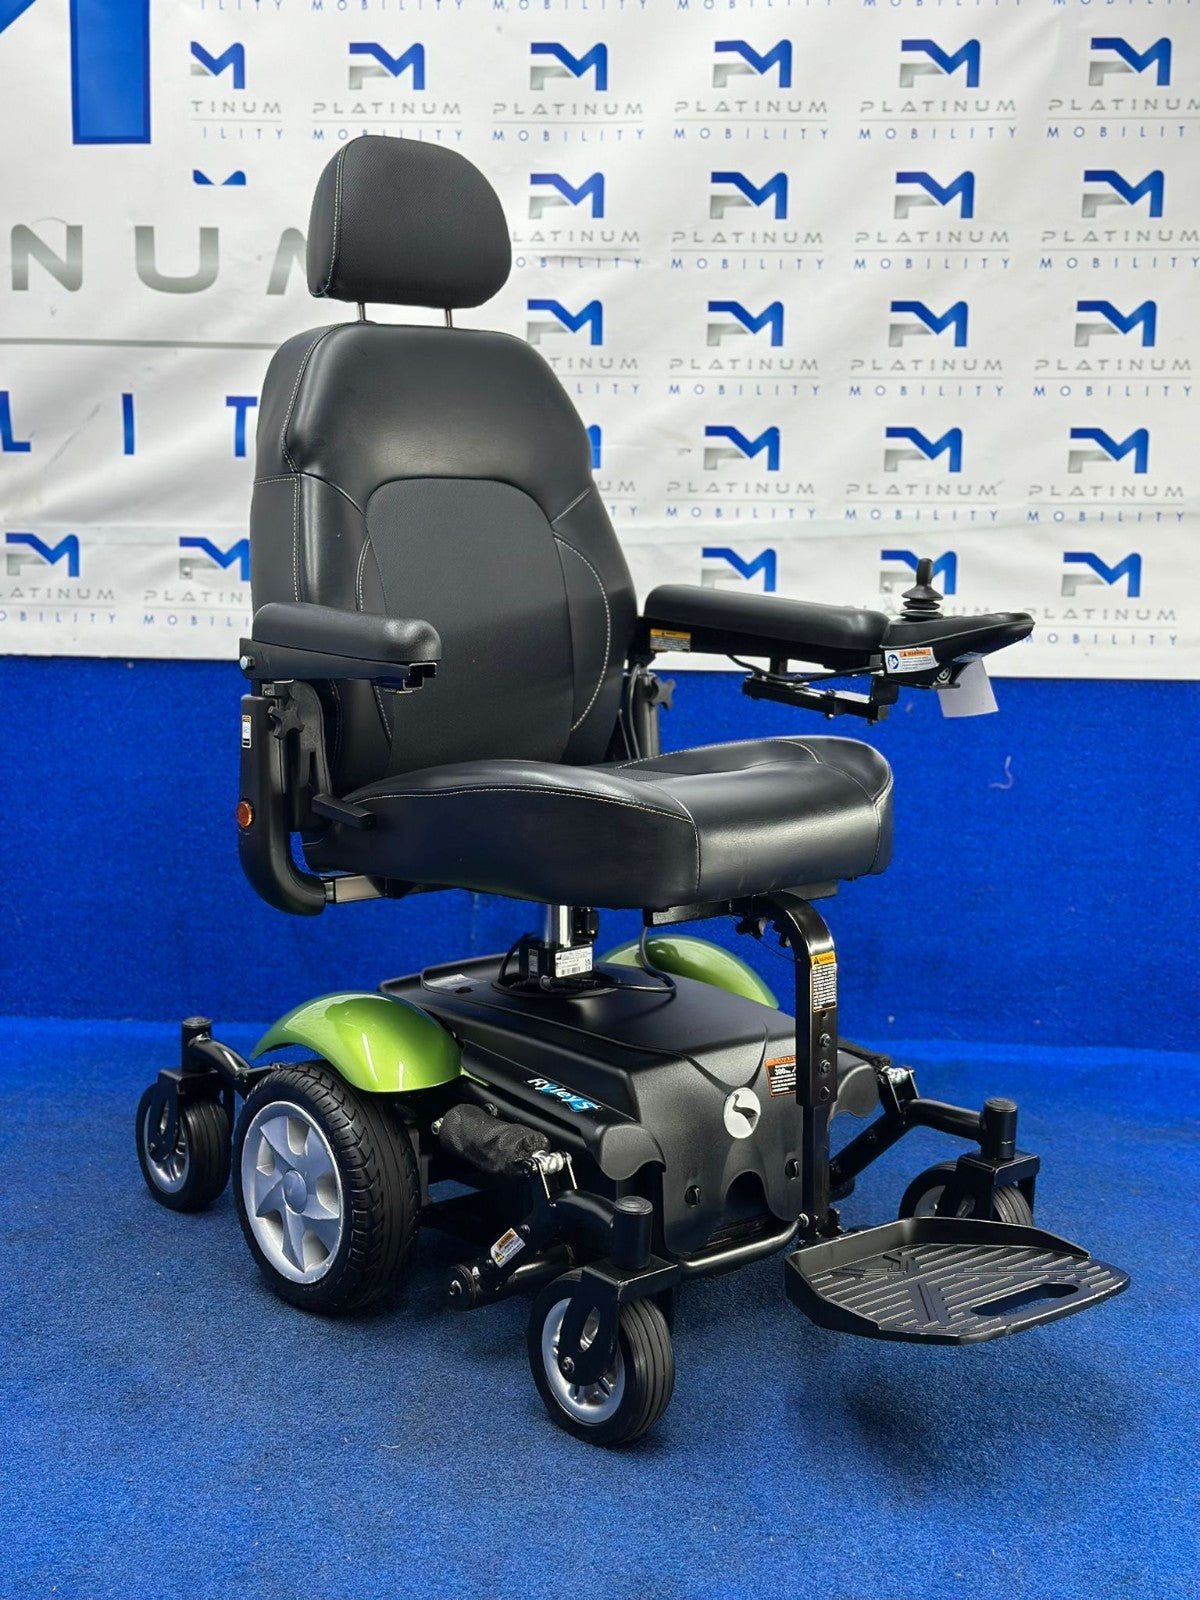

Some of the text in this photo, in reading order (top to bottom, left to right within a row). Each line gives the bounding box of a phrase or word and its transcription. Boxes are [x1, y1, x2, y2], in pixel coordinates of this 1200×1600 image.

[311, 0, 463, 11] MOBILITY
[492, 0, 646, 11] MOBILITY
[313, 102, 461, 115] PLATINUM
[493, 102, 643, 116] PLATINUM
[674, 100, 827, 113] PLATINUM
[860, 100, 1016, 113] PLATINUM
[492, 129, 644, 143] MOBILITY
[673, 127, 828, 140] MOBILITY
[858, 126, 1016, 140] MOBILITY
[672, 231, 823, 244] PLATINUM
[855, 230, 1009, 243] PLATINUM
[1041, 229, 1200, 243] PLATINUM
[670, 257, 824, 271] MOBILITY
[853, 256, 1010, 270] MOBILITY
[1040, 256, 1200, 269] MOBILITY
[669, 358, 818, 371] PLATINUM
[850, 359, 1003, 371] PLATINUM
[1034, 358, 1191, 371] PLATINUM
[668, 384, 820, 396] MOBILITY
[849, 385, 1004, 397] MOBILITY
[1033, 385, 1192, 397] MOBILITY
[666, 481, 814, 494] PLATINUM
[846, 483, 997, 496] PLATINUM
[1028, 485, 1184, 497] PLATINUM
[666, 506, 816, 519] MOBILITY
[845, 508, 998, 522] MOBILITY
[1026, 511, 1184, 523] MOBILITY
